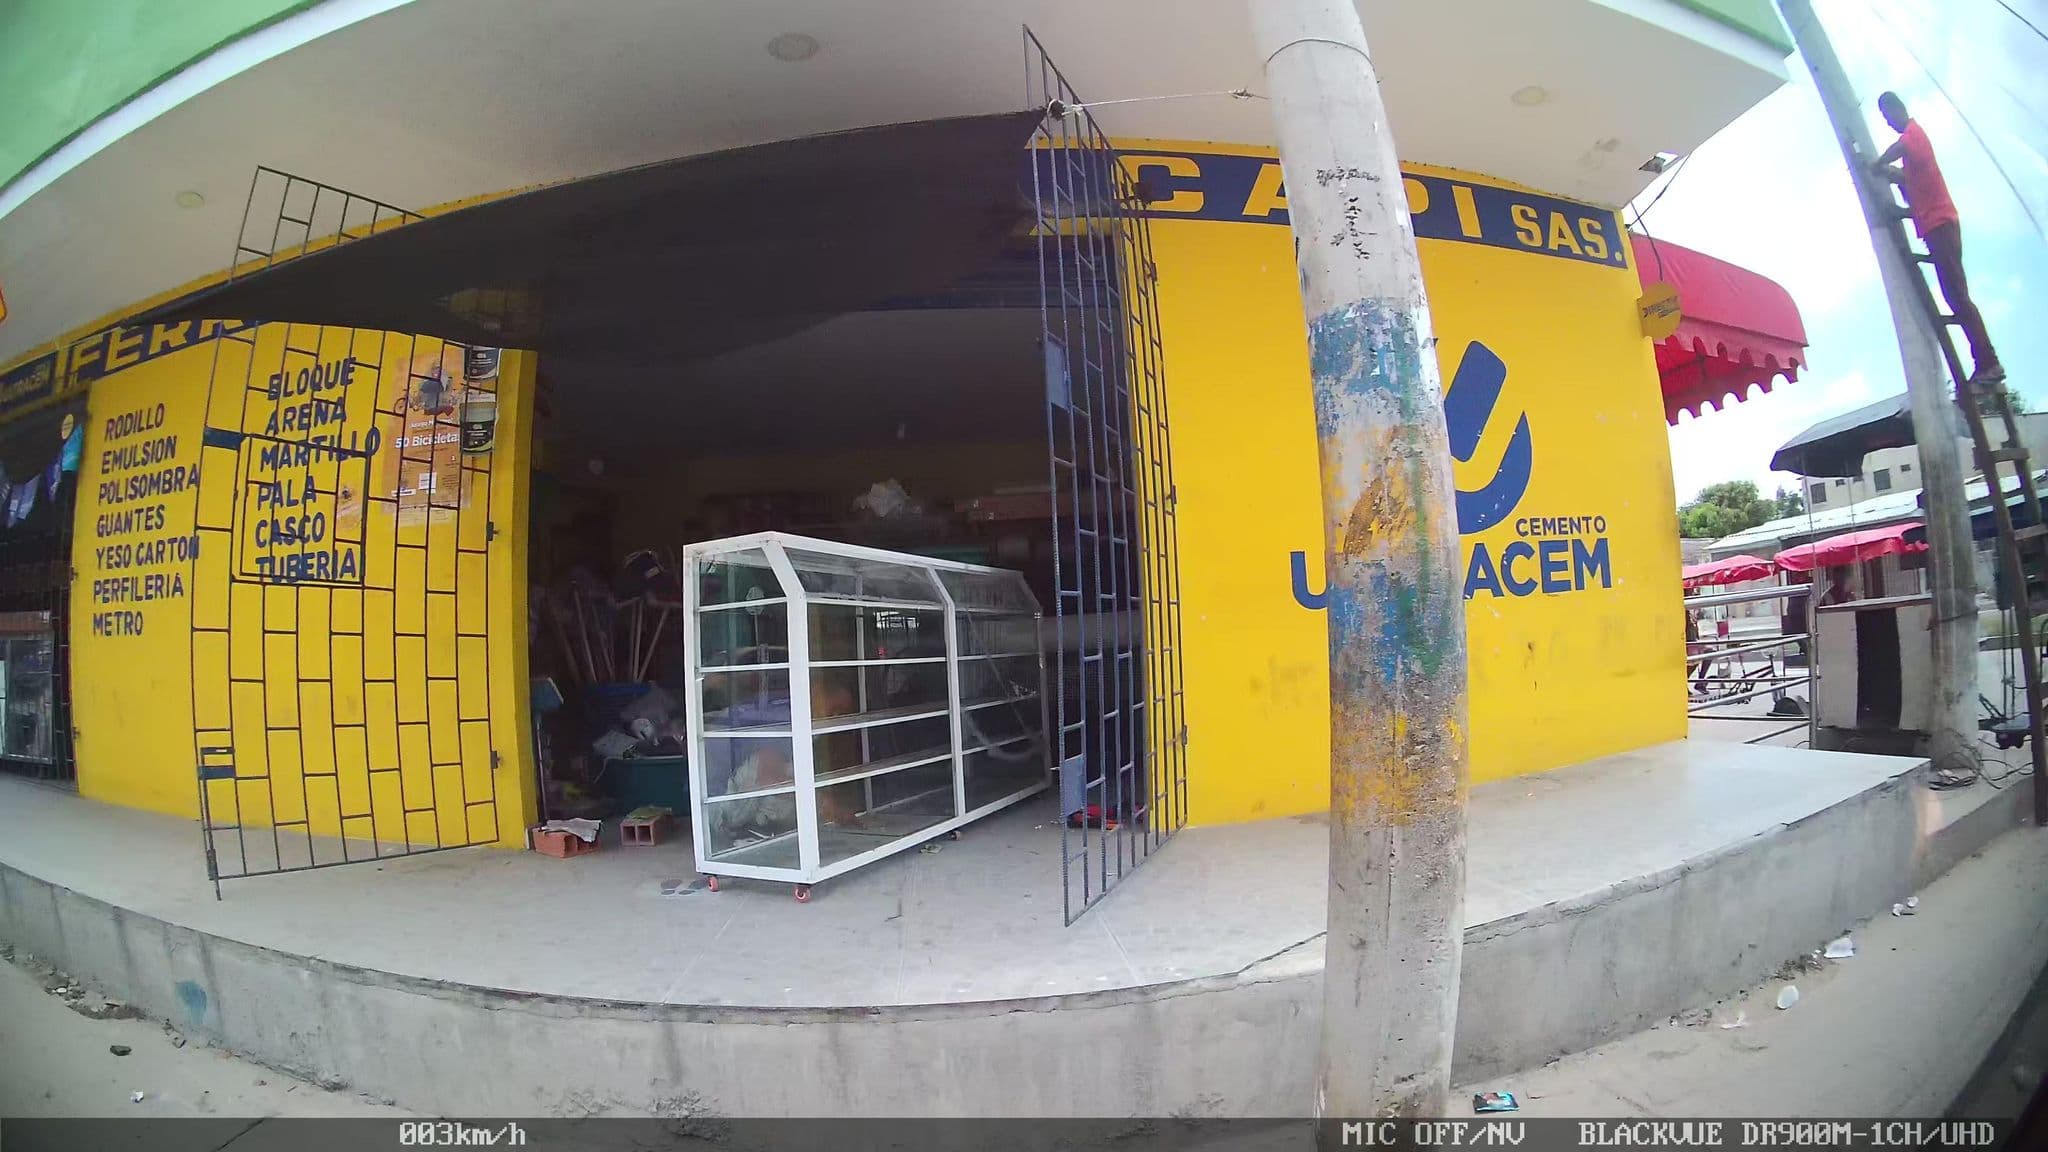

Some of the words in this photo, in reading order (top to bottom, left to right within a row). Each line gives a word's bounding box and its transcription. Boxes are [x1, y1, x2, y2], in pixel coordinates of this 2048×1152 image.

[1510, 204, 1623, 262] SAS.
[267, 357, 356, 401] BLOQUE
[105, 402, 165, 441] RODILLO
[265, 396, 347, 437] ARENA
[101, 435, 178, 475] EMULSION
[260, 427, 381, 473] MARTILLO
[98, 463, 199, 506] POLISOMBRA
[257, 475, 317, 512] PALA
[96, 504, 165, 538] GUANTES
[255, 511, 325, 548] CASCO
[1516, 515, 1606, 537] CEMENTO
[96, 543, 132, 571] YESO
[135, 535, 199, 567] CARTON
[255, 548, 357, 584] TUBERIA
[93, 572, 184, 605] PERFILERIA
[1290, 538, 1612, 610] UACEM
[93, 610, 144, 637] METRO
